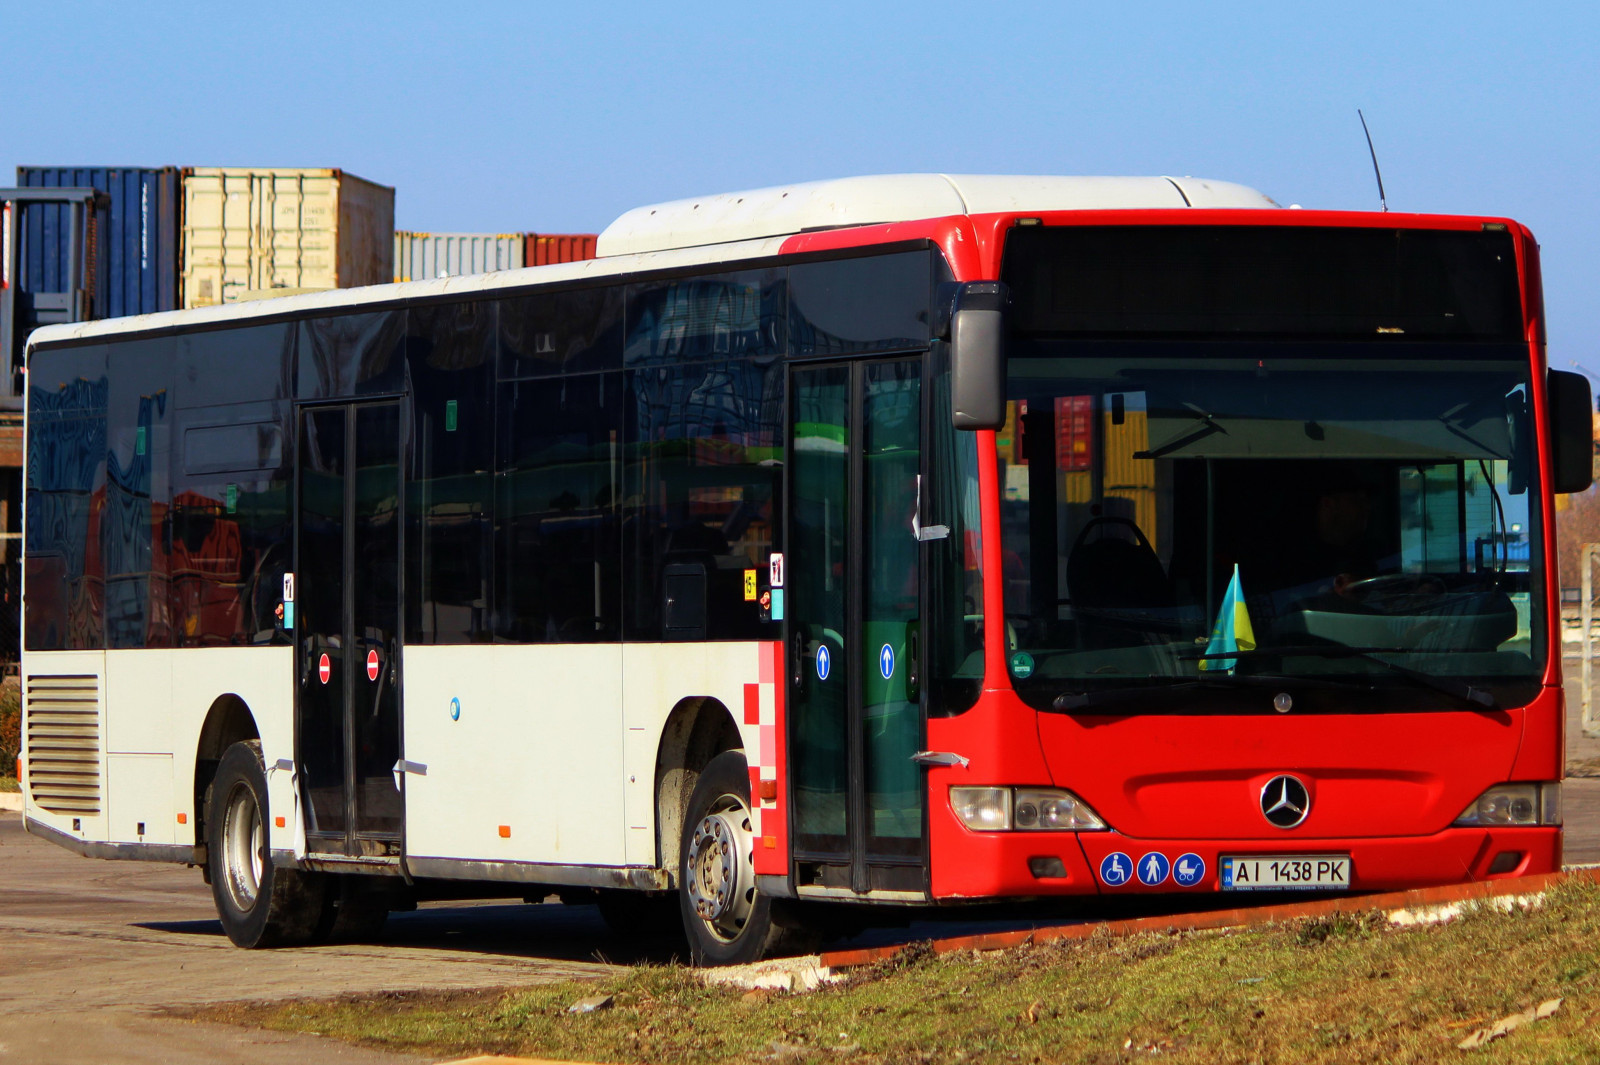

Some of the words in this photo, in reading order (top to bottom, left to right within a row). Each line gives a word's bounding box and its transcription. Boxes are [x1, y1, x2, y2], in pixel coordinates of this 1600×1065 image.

[1019, 656, 1025, 665] 4
[1236, 862, 1259, 882] AI
[1270, 862, 1312, 882] 1438
[1317, 861, 1344, 881] PK
